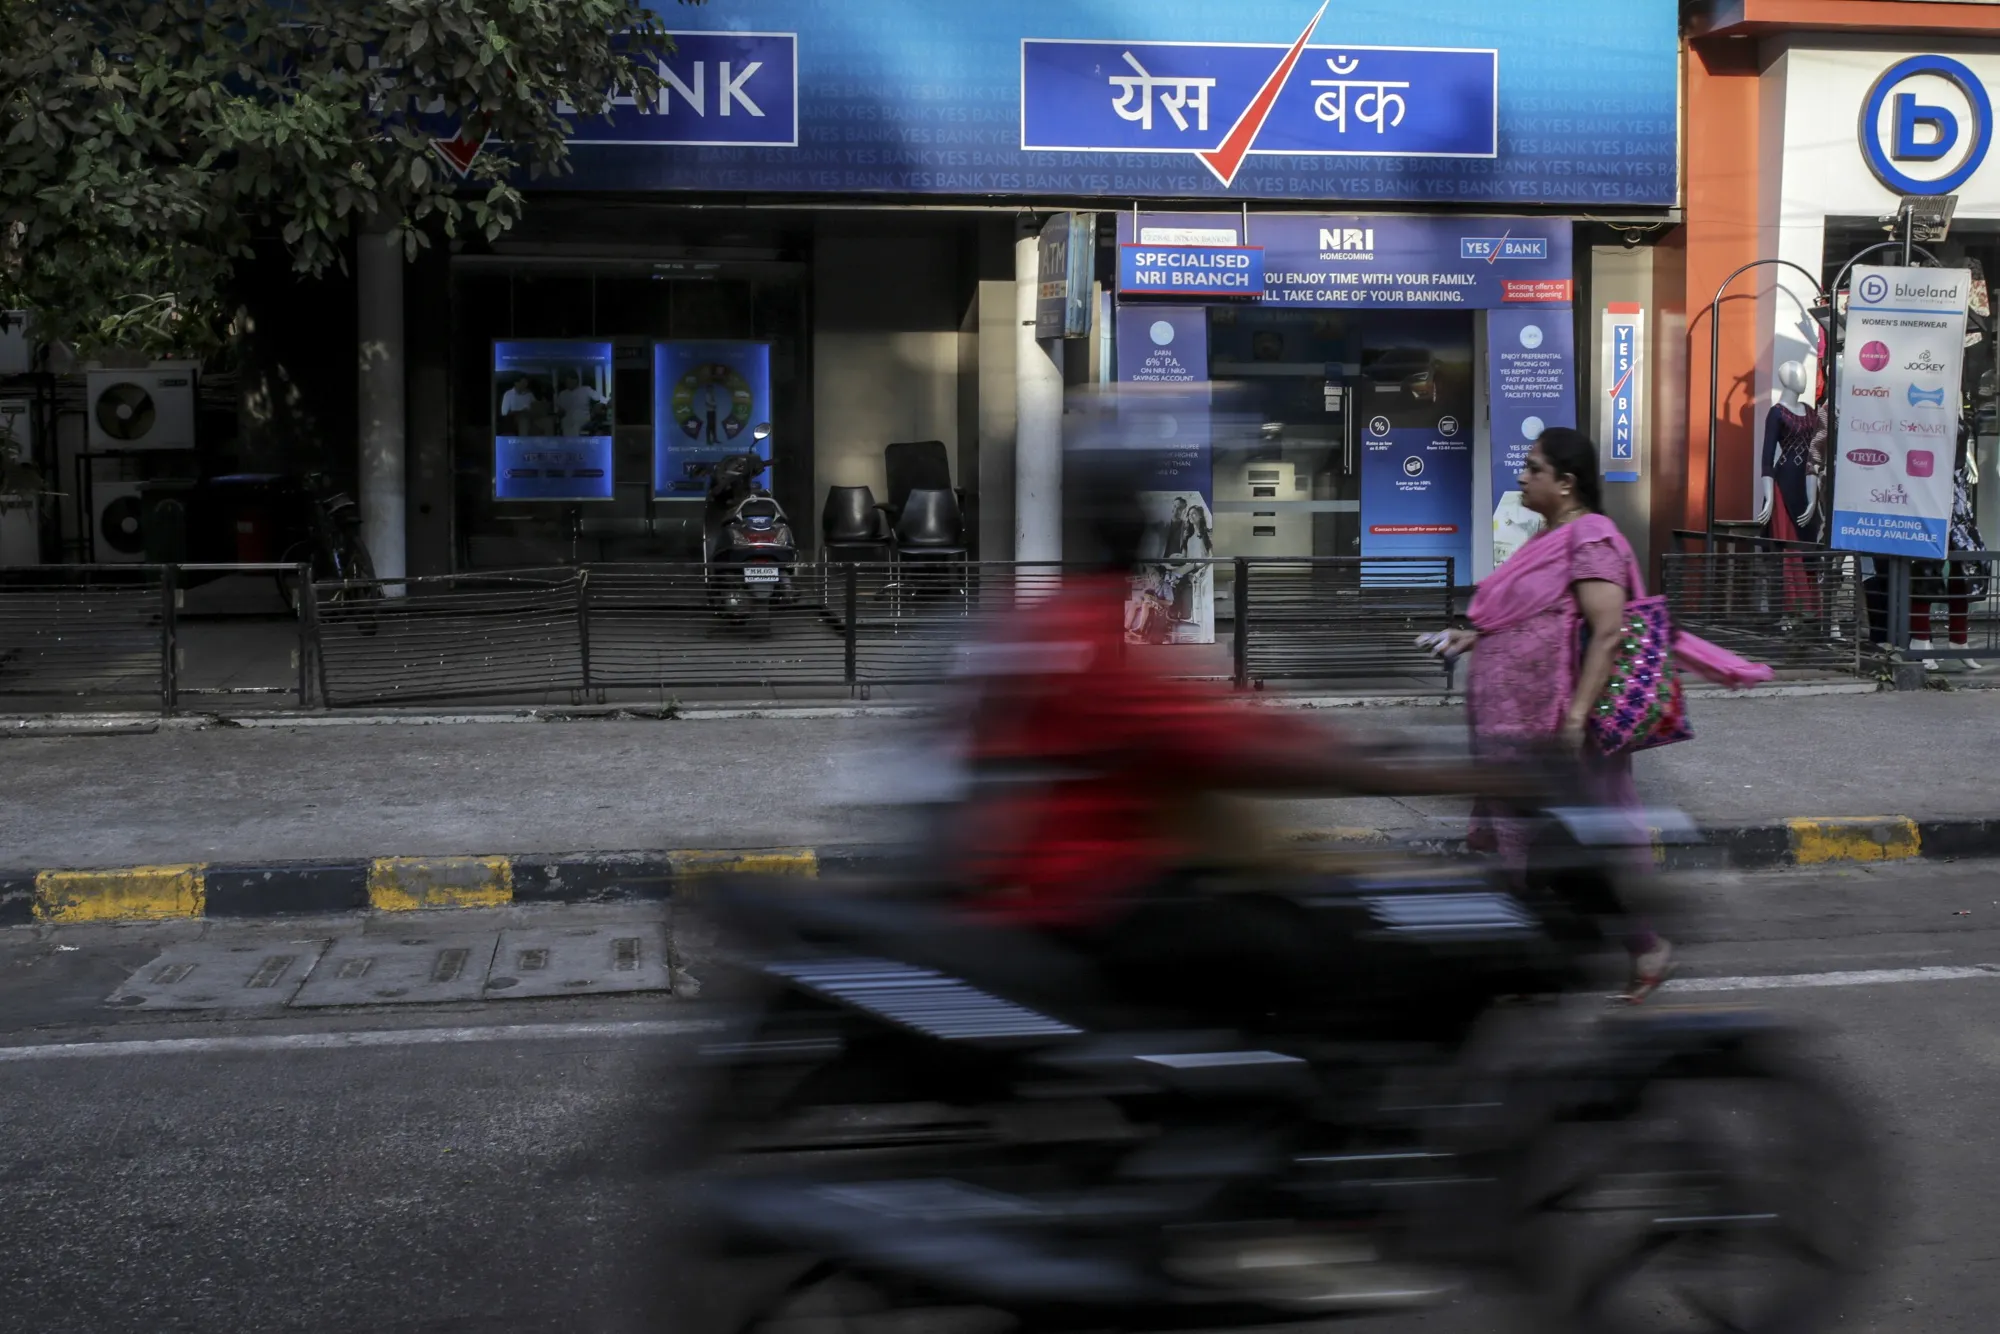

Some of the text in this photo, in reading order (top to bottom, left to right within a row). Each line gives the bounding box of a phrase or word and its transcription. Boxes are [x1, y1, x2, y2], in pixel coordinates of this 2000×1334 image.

[1109, 50, 1216, 132] येस
[1891, 92, 1959, 162] b
[808, 172, 841, 187] YES
[845, 172, 894, 188] BANK
[899, 173, 932, 188] YES
[935, 173, 985, 189] BANK
[989, 174, 1021, 189] YES
[1026, 175, 1073, 190] BANK
[1078, 175, 1110, 190] YES
[1114, 176, 1163, 191] BANK
[1166, 176, 1198, 192] YES
[1254, 177, 1286, 193] YES
[1289, 178, 1336, 193] BANK
[1340, 178, 1371, 194] YES
[1374, 179, 1420, 194] BANK
[1424, 179, 1455, 195] YES
[1458, 180, 1503, 195] BANK
[1508, 181, 1539, 196] YES
[1542, 181, 1587, 196] BANK
[1591, 182, 1621, 197] YES
[1625, 182, 1669, 197] BANK
[1319, 228, 1374, 250] NRI
[1466, 242, 1541, 254] YES BANK
[1135, 252, 1250, 268] SPECIALISED
[1319, 252, 1374, 261] HOMECOMING
[1135, 271, 1249, 286] NRI BRANCH
[1263, 272, 1477, 285] OU ENJOY TIME WITH YOUR FAMILY.
[1507, 282, 1534, 292] Exciting
[1535, 282, 1554, 291] offers
[1895, 283, 1958, 299] blueland
[1283, 290, 1313, 301] TAKE
[1316, 290, 1353, 301] CARE
[1355, 290, 1368, 301] OF
[1370, 291, 1404, 301] YOUR
[1406, 291, 1465, 302] BANKING.
[1536, 291, 1563, 299] opening
[1861, 318, 1948, 329] WOMEN'S INNERWEAR
[1617, 327, 1629, 371] YES
[1164, 357, 1181, 367] P.A.
[1904, 362, 1945, 371] JOCKEY
[1616, 397, 1629, 457] BANK
[1850, 451, 1888, 463] TRYLO
[1857, 517, 1922, 530] ALL LEADING
[1841, 526, 1938, 543] BRANDS AVAILABLE
